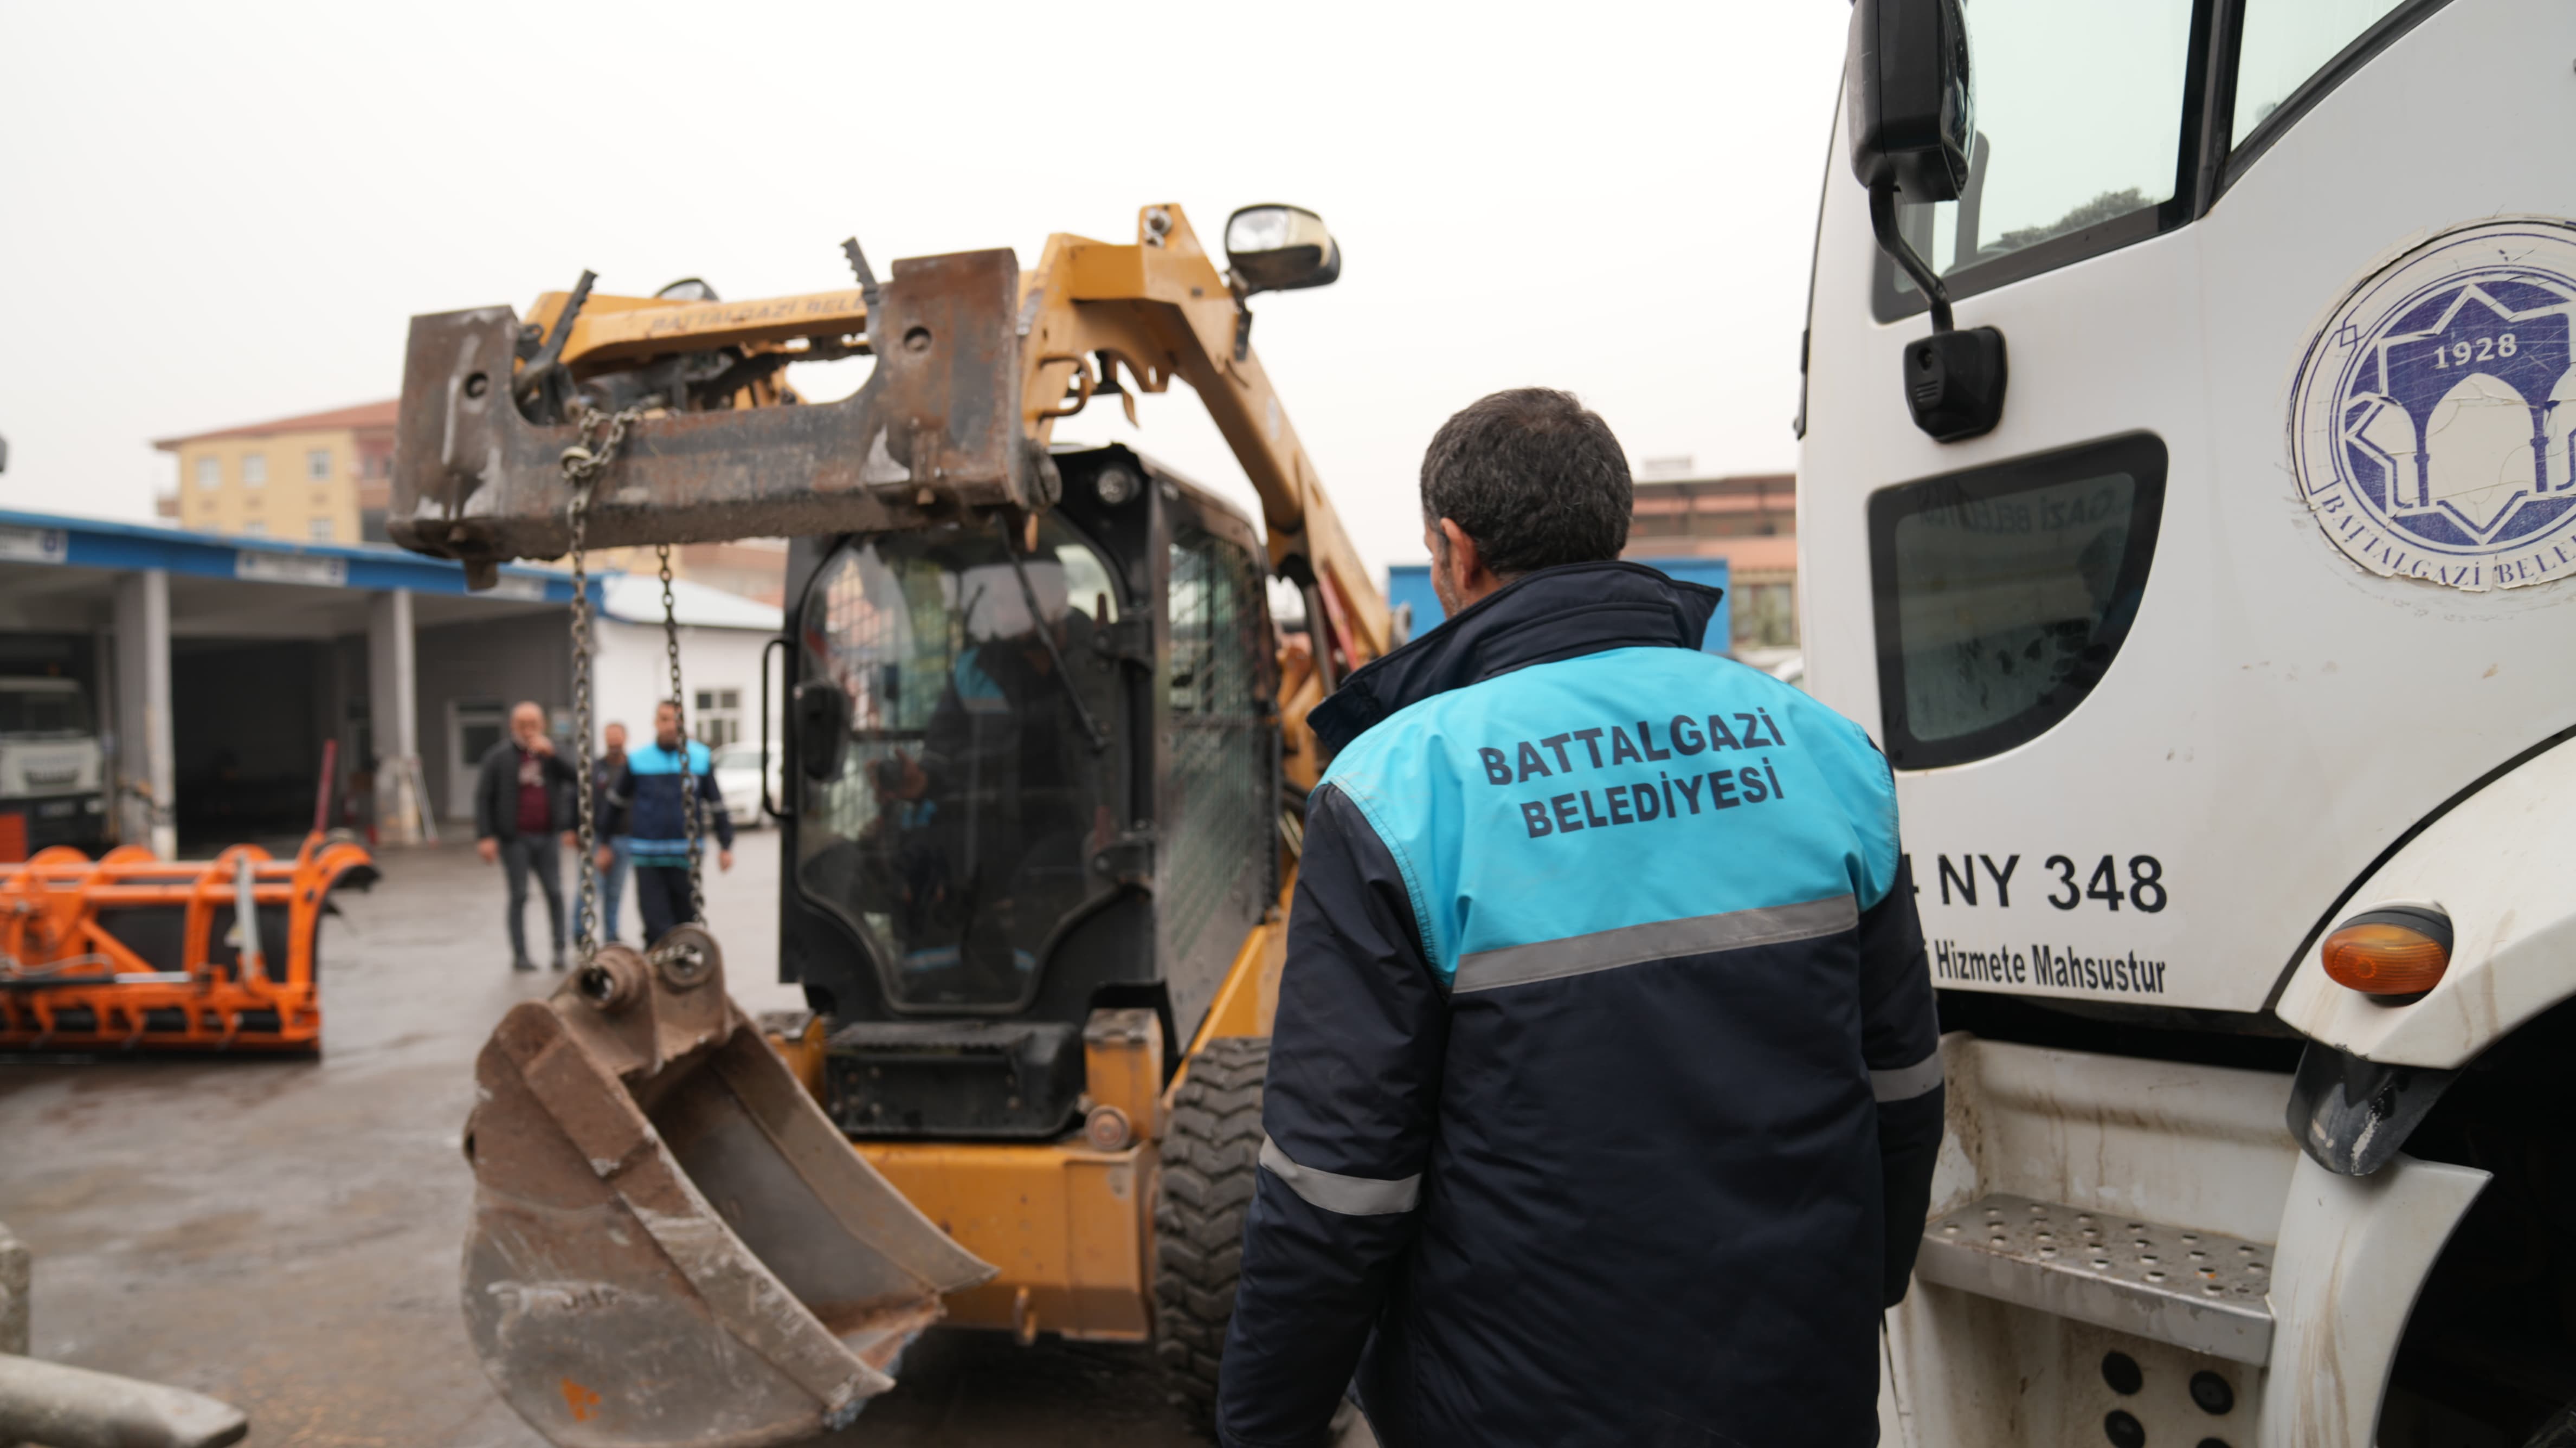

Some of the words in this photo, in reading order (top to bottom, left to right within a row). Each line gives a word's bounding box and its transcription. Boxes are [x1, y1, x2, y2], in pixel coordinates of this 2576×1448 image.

[2433, 333, 2517, 369] 1928
[2322, 495, 2480, 585] BATTALGAZİ
[1478, 707, 1786, 785] BATTALGAZİ
[1519, 757, 1784, 838] BELEDİYESİ
[1937, 854, 2021, 907] NY
[2044, 855, 2167, 913] 348
[1934, 939, 2026, 984] Hizmete
[2031, 945, 2166, 993] Mahsustur
